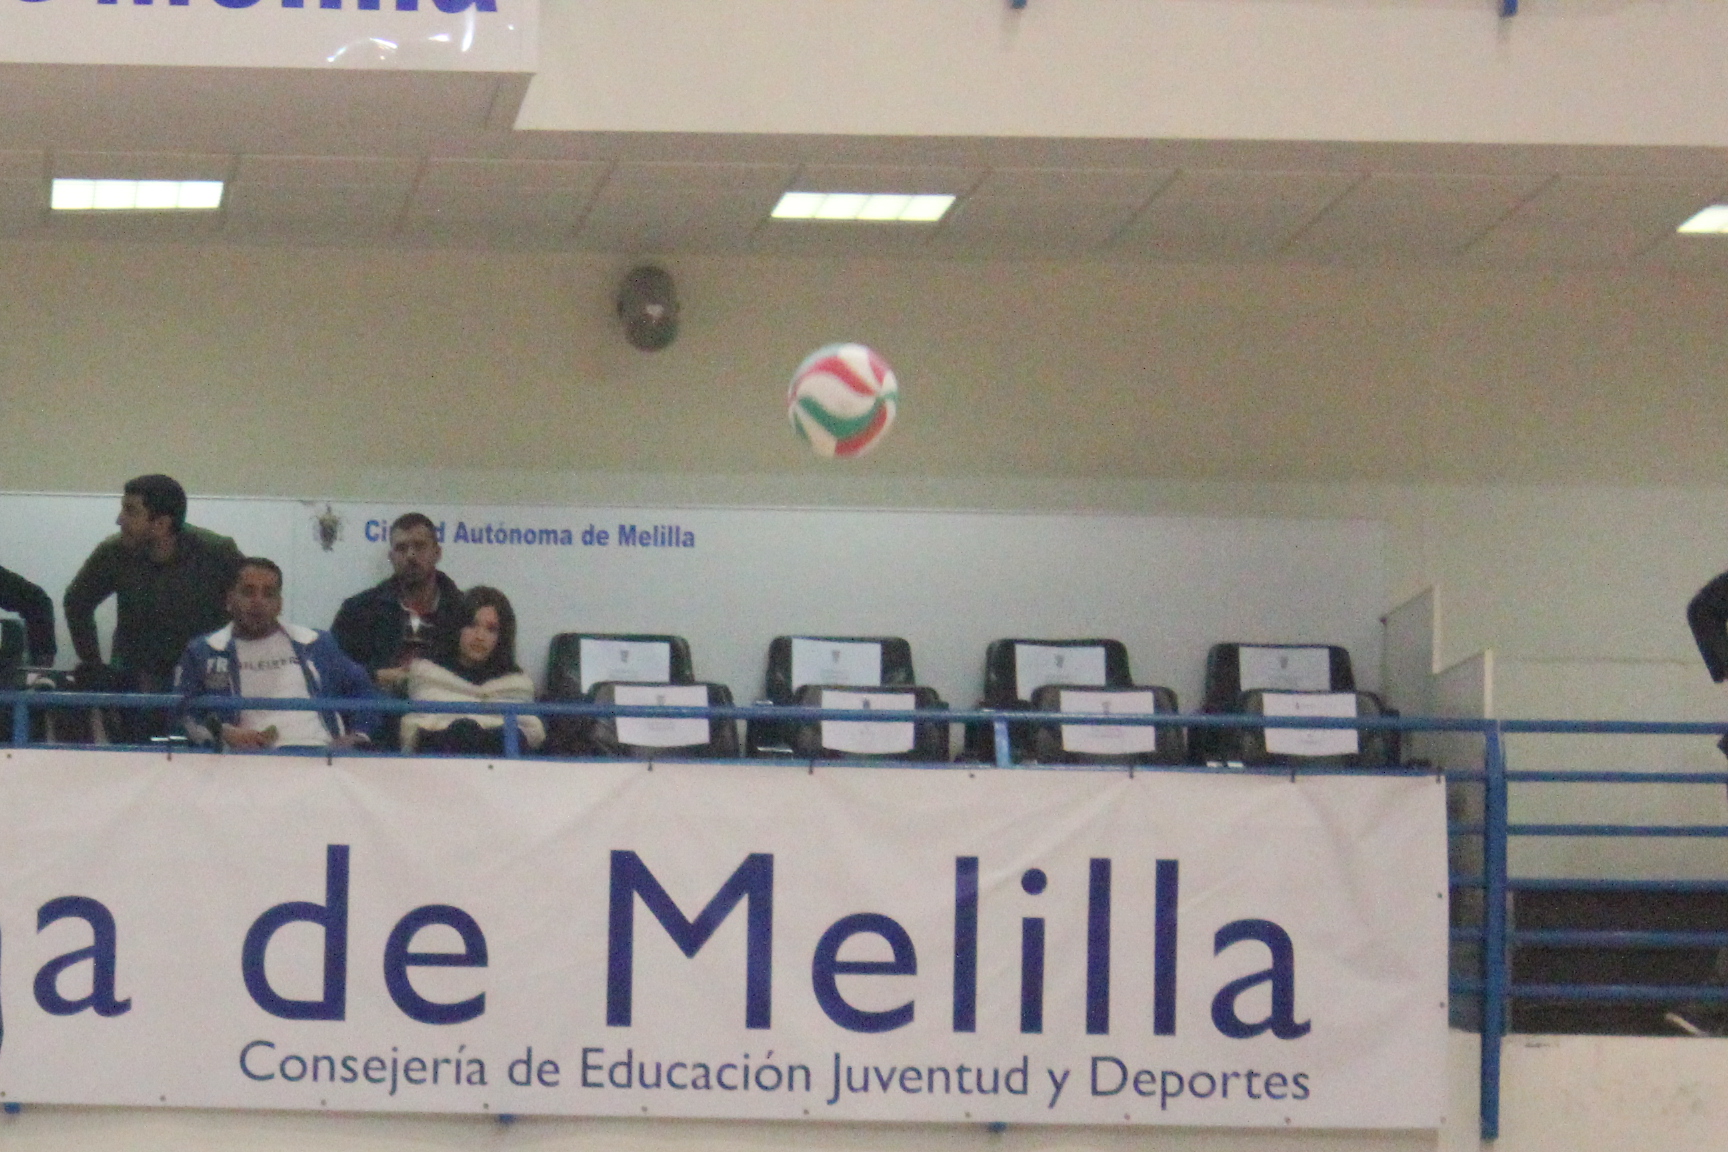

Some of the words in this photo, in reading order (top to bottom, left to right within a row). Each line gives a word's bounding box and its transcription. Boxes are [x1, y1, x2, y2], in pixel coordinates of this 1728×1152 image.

[364, 519, 445, 543] Cid
[453, 521, 572, 546] Autónoma
[581, 523, 610, 547] de
[618, 524, 696, 548] Melilla
[241, 844, 490, 1025] de
[606, 849, 1312, 1040] Melilla
[239, 1040, 487, 1096] Consejería
[508, 1047, 561, 1088] de
[580, 1046, 811, 1093] Educación
[826, 1052, 1029, 1105] Juventud
[1046, 1065, 1071, 1108] y
[1091, 1055, 1311, 1111] Deportes
